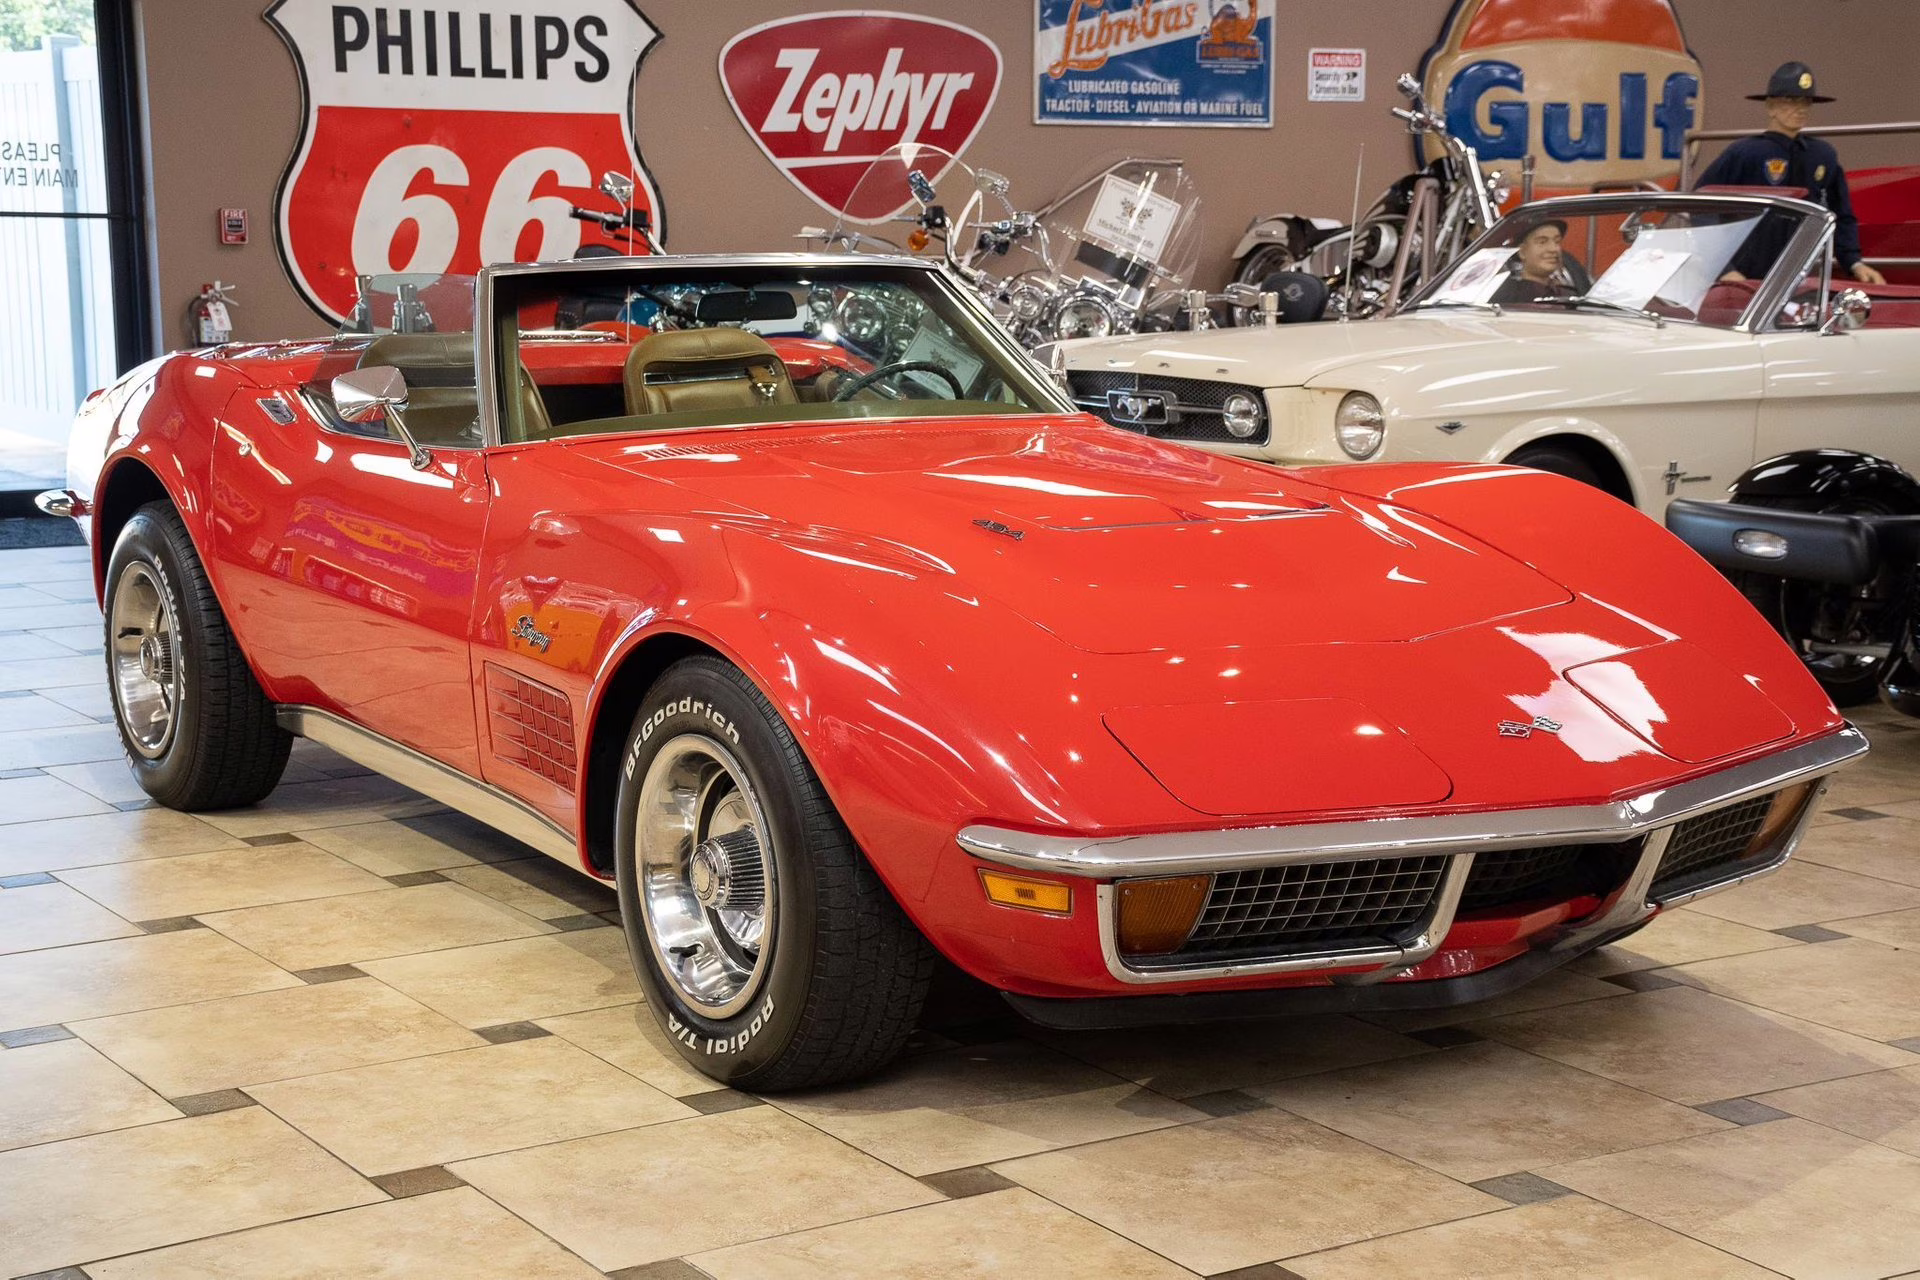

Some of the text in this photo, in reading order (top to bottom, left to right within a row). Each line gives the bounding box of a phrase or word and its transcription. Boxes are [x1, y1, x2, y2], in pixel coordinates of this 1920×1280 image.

[332, 5, 611, 83] PHILLIPS
[760, 47, 976, 169] Zephyr
[1046, 99, 1263, 116] TRACTOR DIESEL AVIATION OR MARINE FUEL
[1068, 80, 1180, 95] LUBRICATED GASOLINE
[1444, 59, 1698, 162] Gulf
[224, 209, 244, 219] FIRE
[351, 144, 592, 294] 66
[626, 696, 740, 781] BFGoodrich
[668, 993, 775, 1056] Radial T/A
